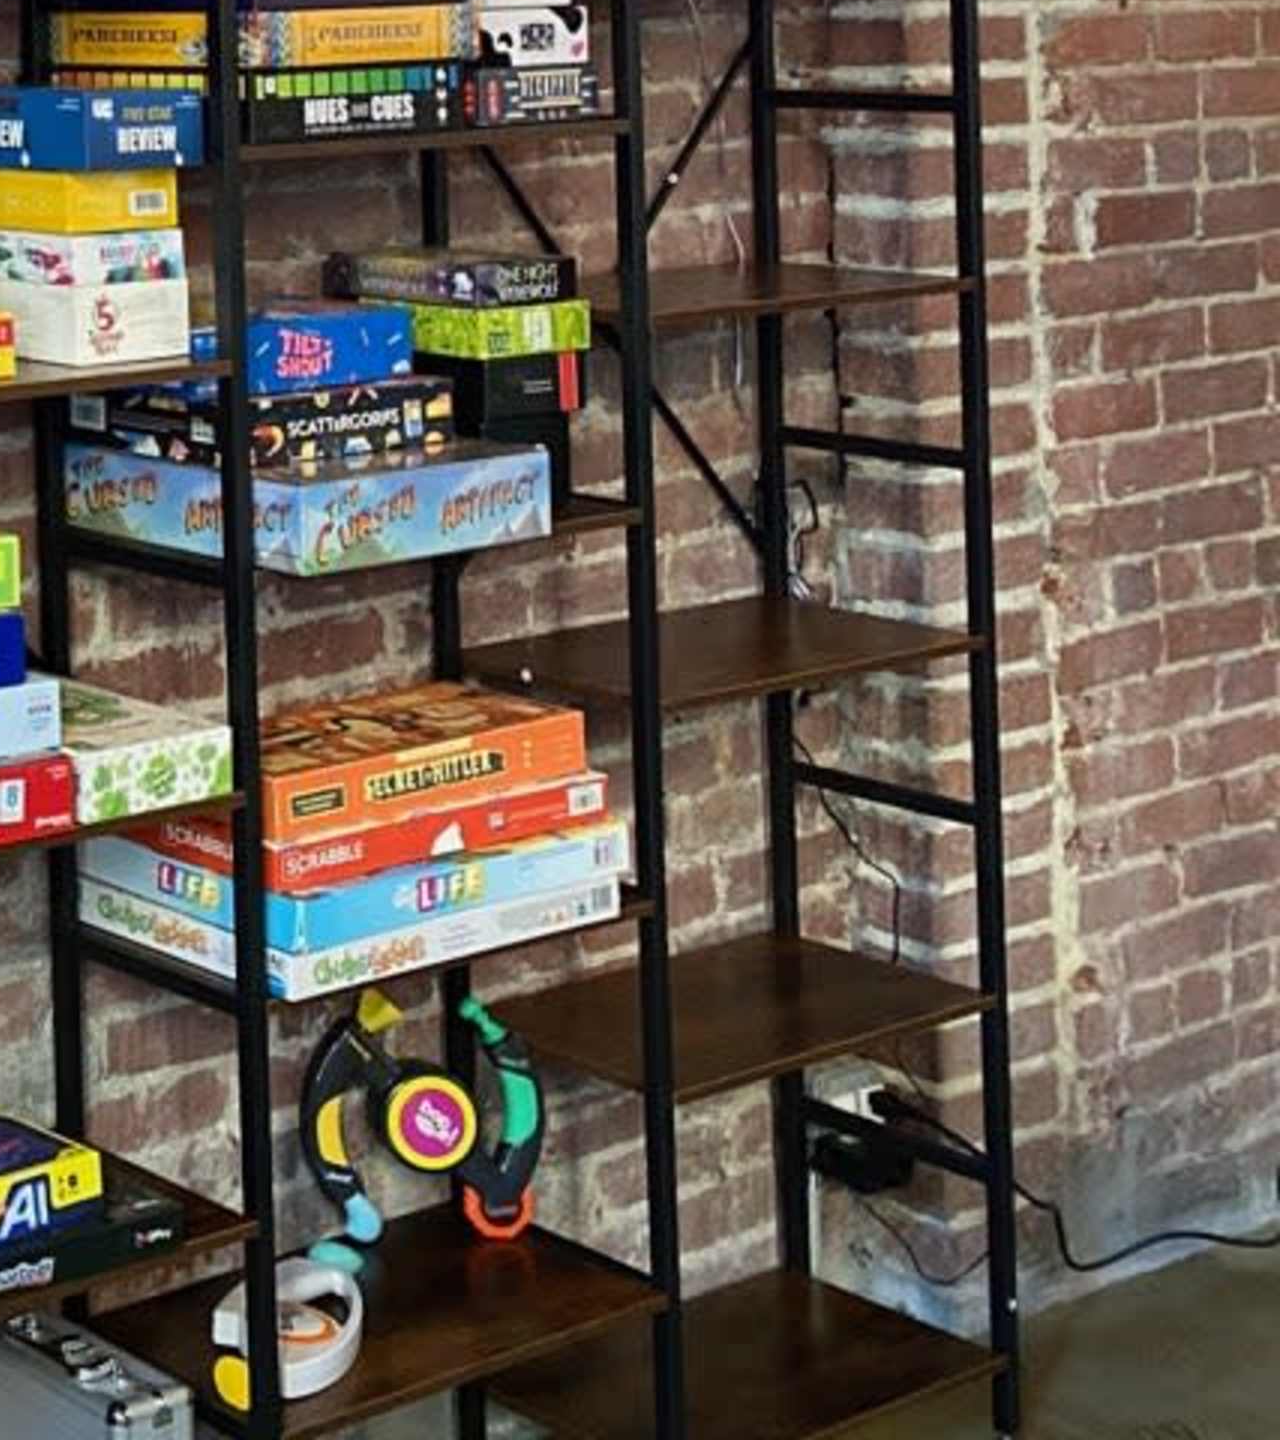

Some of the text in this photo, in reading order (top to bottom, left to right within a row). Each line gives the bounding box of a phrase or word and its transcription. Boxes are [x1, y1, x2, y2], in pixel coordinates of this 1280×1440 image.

[74, 27, 178, 44] PARCHEESI
[319, 23, 424, 40] PARCHEESI
[304, 97, 350, 124] HUES
[370, 92, 415, 121] CUES
[116, 125, 178, 154] REVIEW
[285, 841, 364, 877] SCRABBLE
[156, 861, 220, 908] LIFE
[416, 863, 485, 913] LIFE
